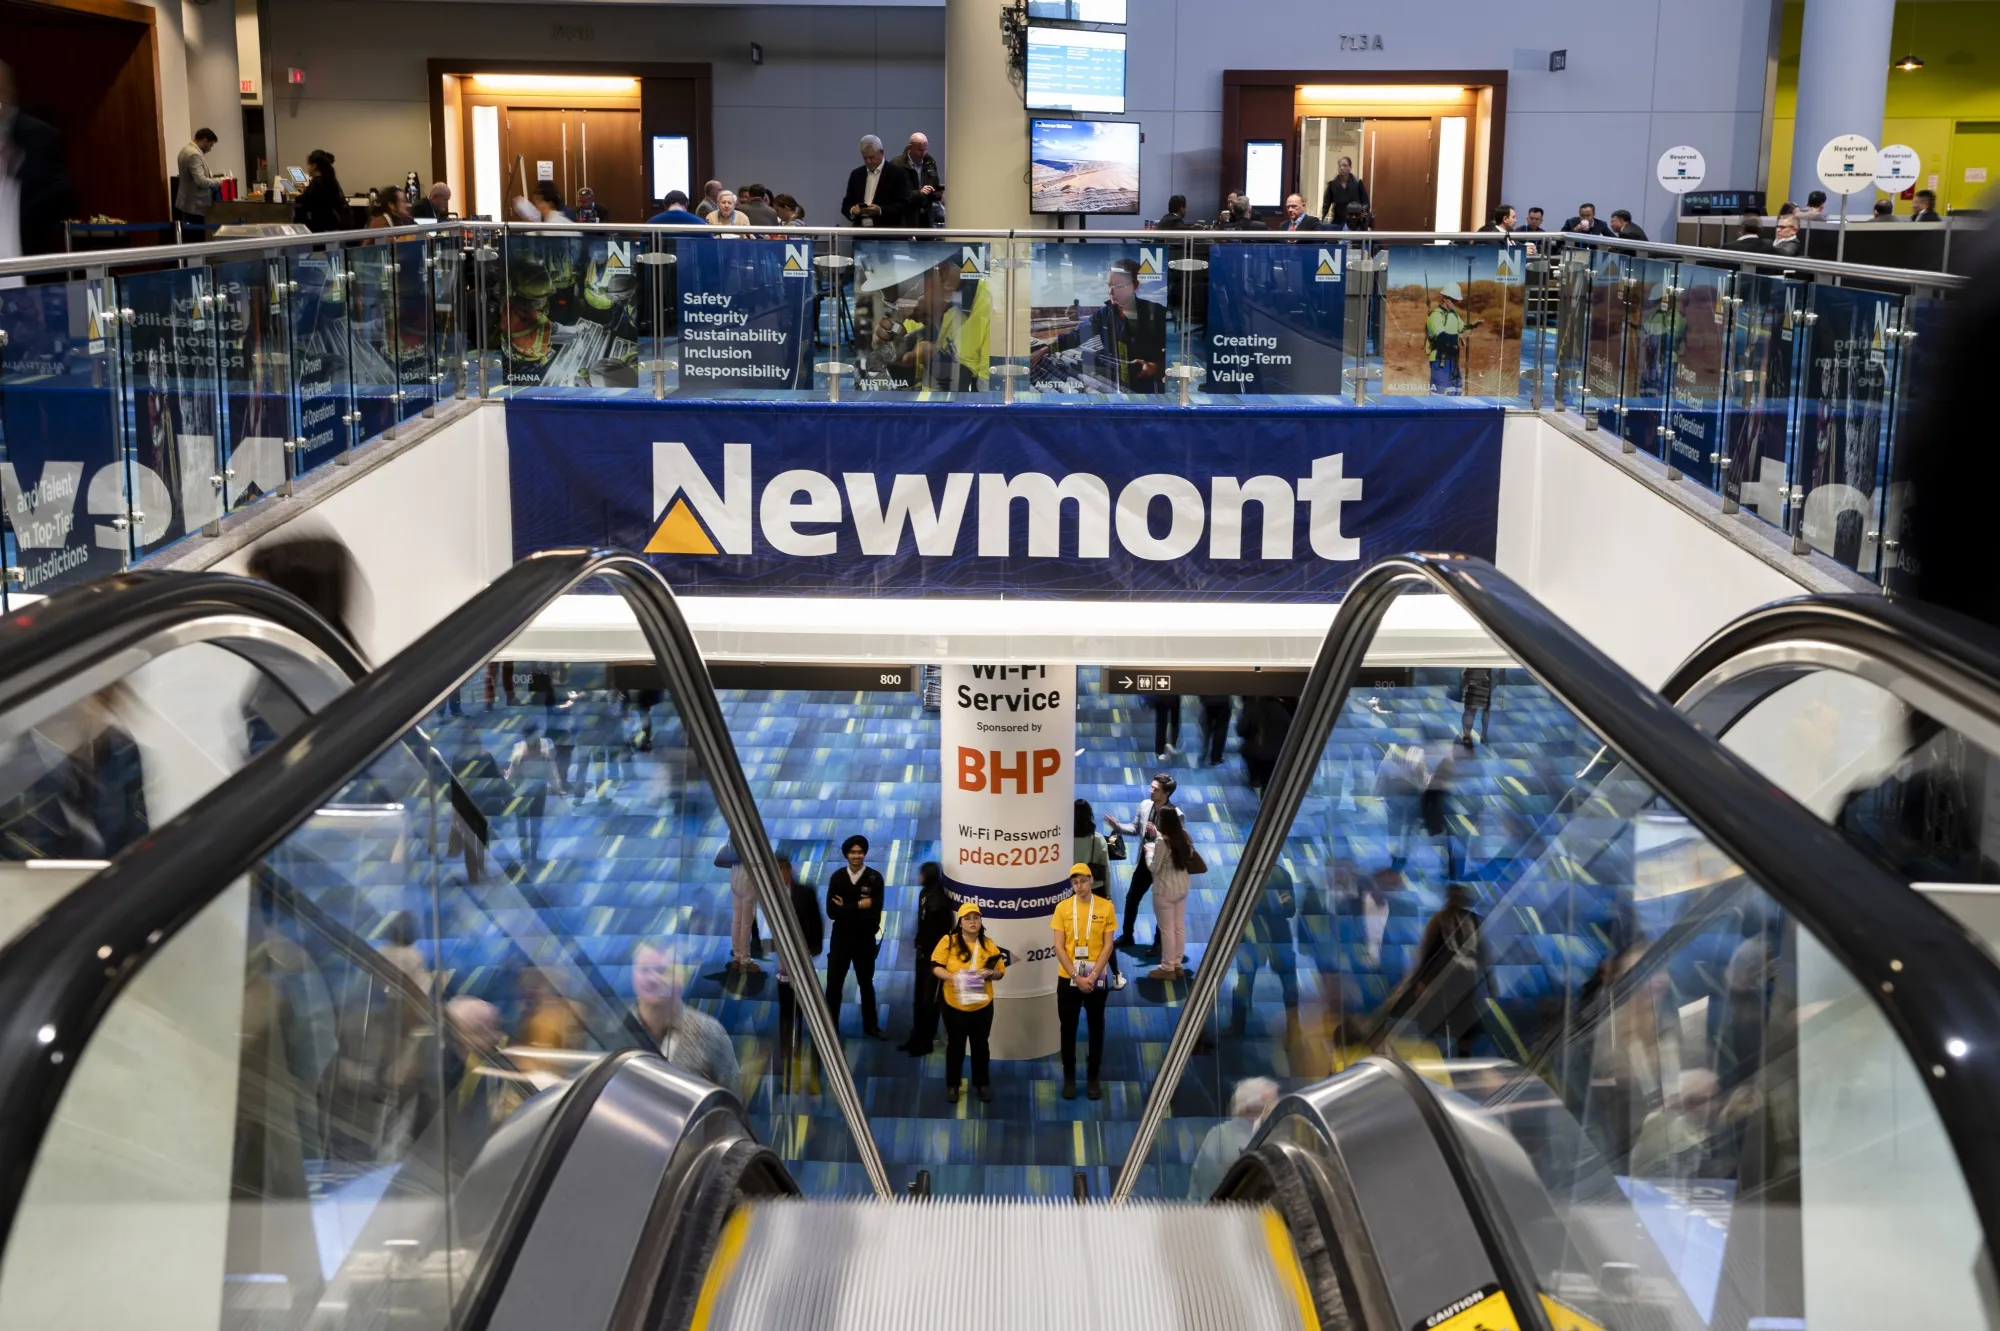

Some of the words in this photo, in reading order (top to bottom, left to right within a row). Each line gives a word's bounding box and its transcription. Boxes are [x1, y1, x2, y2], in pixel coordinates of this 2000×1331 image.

[684, 292, 732, 308] Safety
[684, 310, 748, 326] Integrity
[684, 328, 786, 344] Sustainability
[1213, 334, 1277, 349] Creating
[684, 346, 752, 359] Inclusion
[1213, 352, 1292, 367] Long-Term
[305, 358, 322, 376] Proven
[685, 364, 790, 380] Responsibility
[1212, 370, 1254, 382] Value
[1681, 364, 1696, 384] Proven
[507, 374, 540, 382] GHANA
[301, 382, 314, 402] Track
[314, 376, 332, 394] Record
[1676, 386, 1686, 407] Track
[1687, 392, 1703, 412] Record
[302, 412, 308, 428] of
[309, 399, 336, 428] Operational
[1673, 412, 1679, 426] of
[1679, 414, 1705, 439] Operational
[17, 482, 39, 514] and
[40, 472, 73, 504] Talent
[645, 442, 1363, 560] Newmont
[20, 526, 31, 552] in
[32, 510, 74, 546] Top-Tier
[23, 544, 88, 590] Jurisdictions
[880, 674, 901, 684] 800
[958, 684, 1060, 712] Service
[977, 722, 1028, 732] Sponsored
[1032, 723, 1042, 732] by
[958, 745, 1060, 795] BHP
[959, 824, 990, 840] Wi-Fi
[994, 825, 1061, 841] Password:
[959, 843, 1060, 866] pdac2023
[1027, 946, 1056, 962] 2023
[1426, 1290, 1484, 1327] CAUTION
